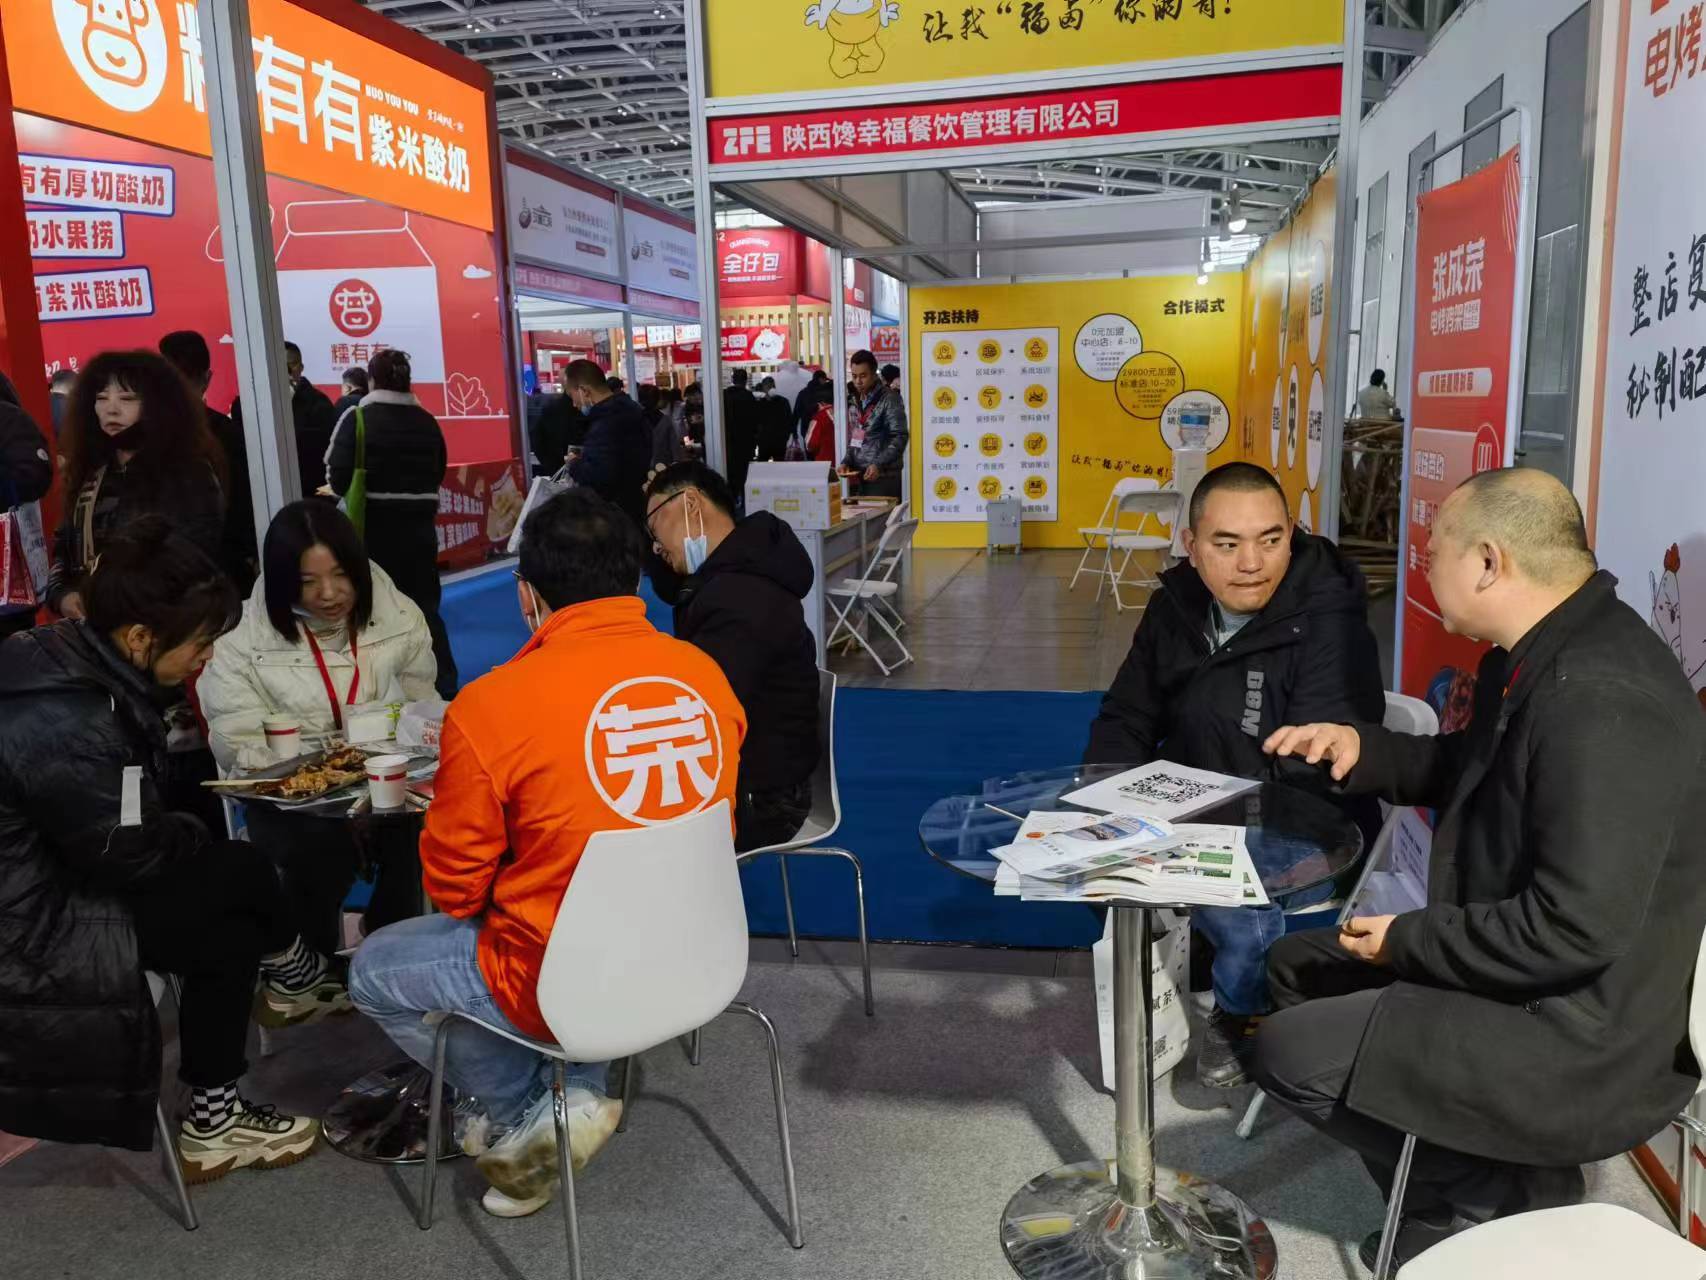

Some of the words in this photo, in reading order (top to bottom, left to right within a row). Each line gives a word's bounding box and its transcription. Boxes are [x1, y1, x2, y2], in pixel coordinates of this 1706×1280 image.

[1644, 2, 1706, 98] 电烤
[368, 112, 471, 193] 紫米酸奶
[782, 99, 1120, 153] 陕西馋幸福餐饮管理有限公司
[36, 277, 143, 314] 紫米酸奶
[1432, 236, 1486, 303] 张成荣
[923, 309, 980, 325] 开店扶持
[1163, 298, 1226, 316] 合作模式
[596, 695, 716, 816] 荣
